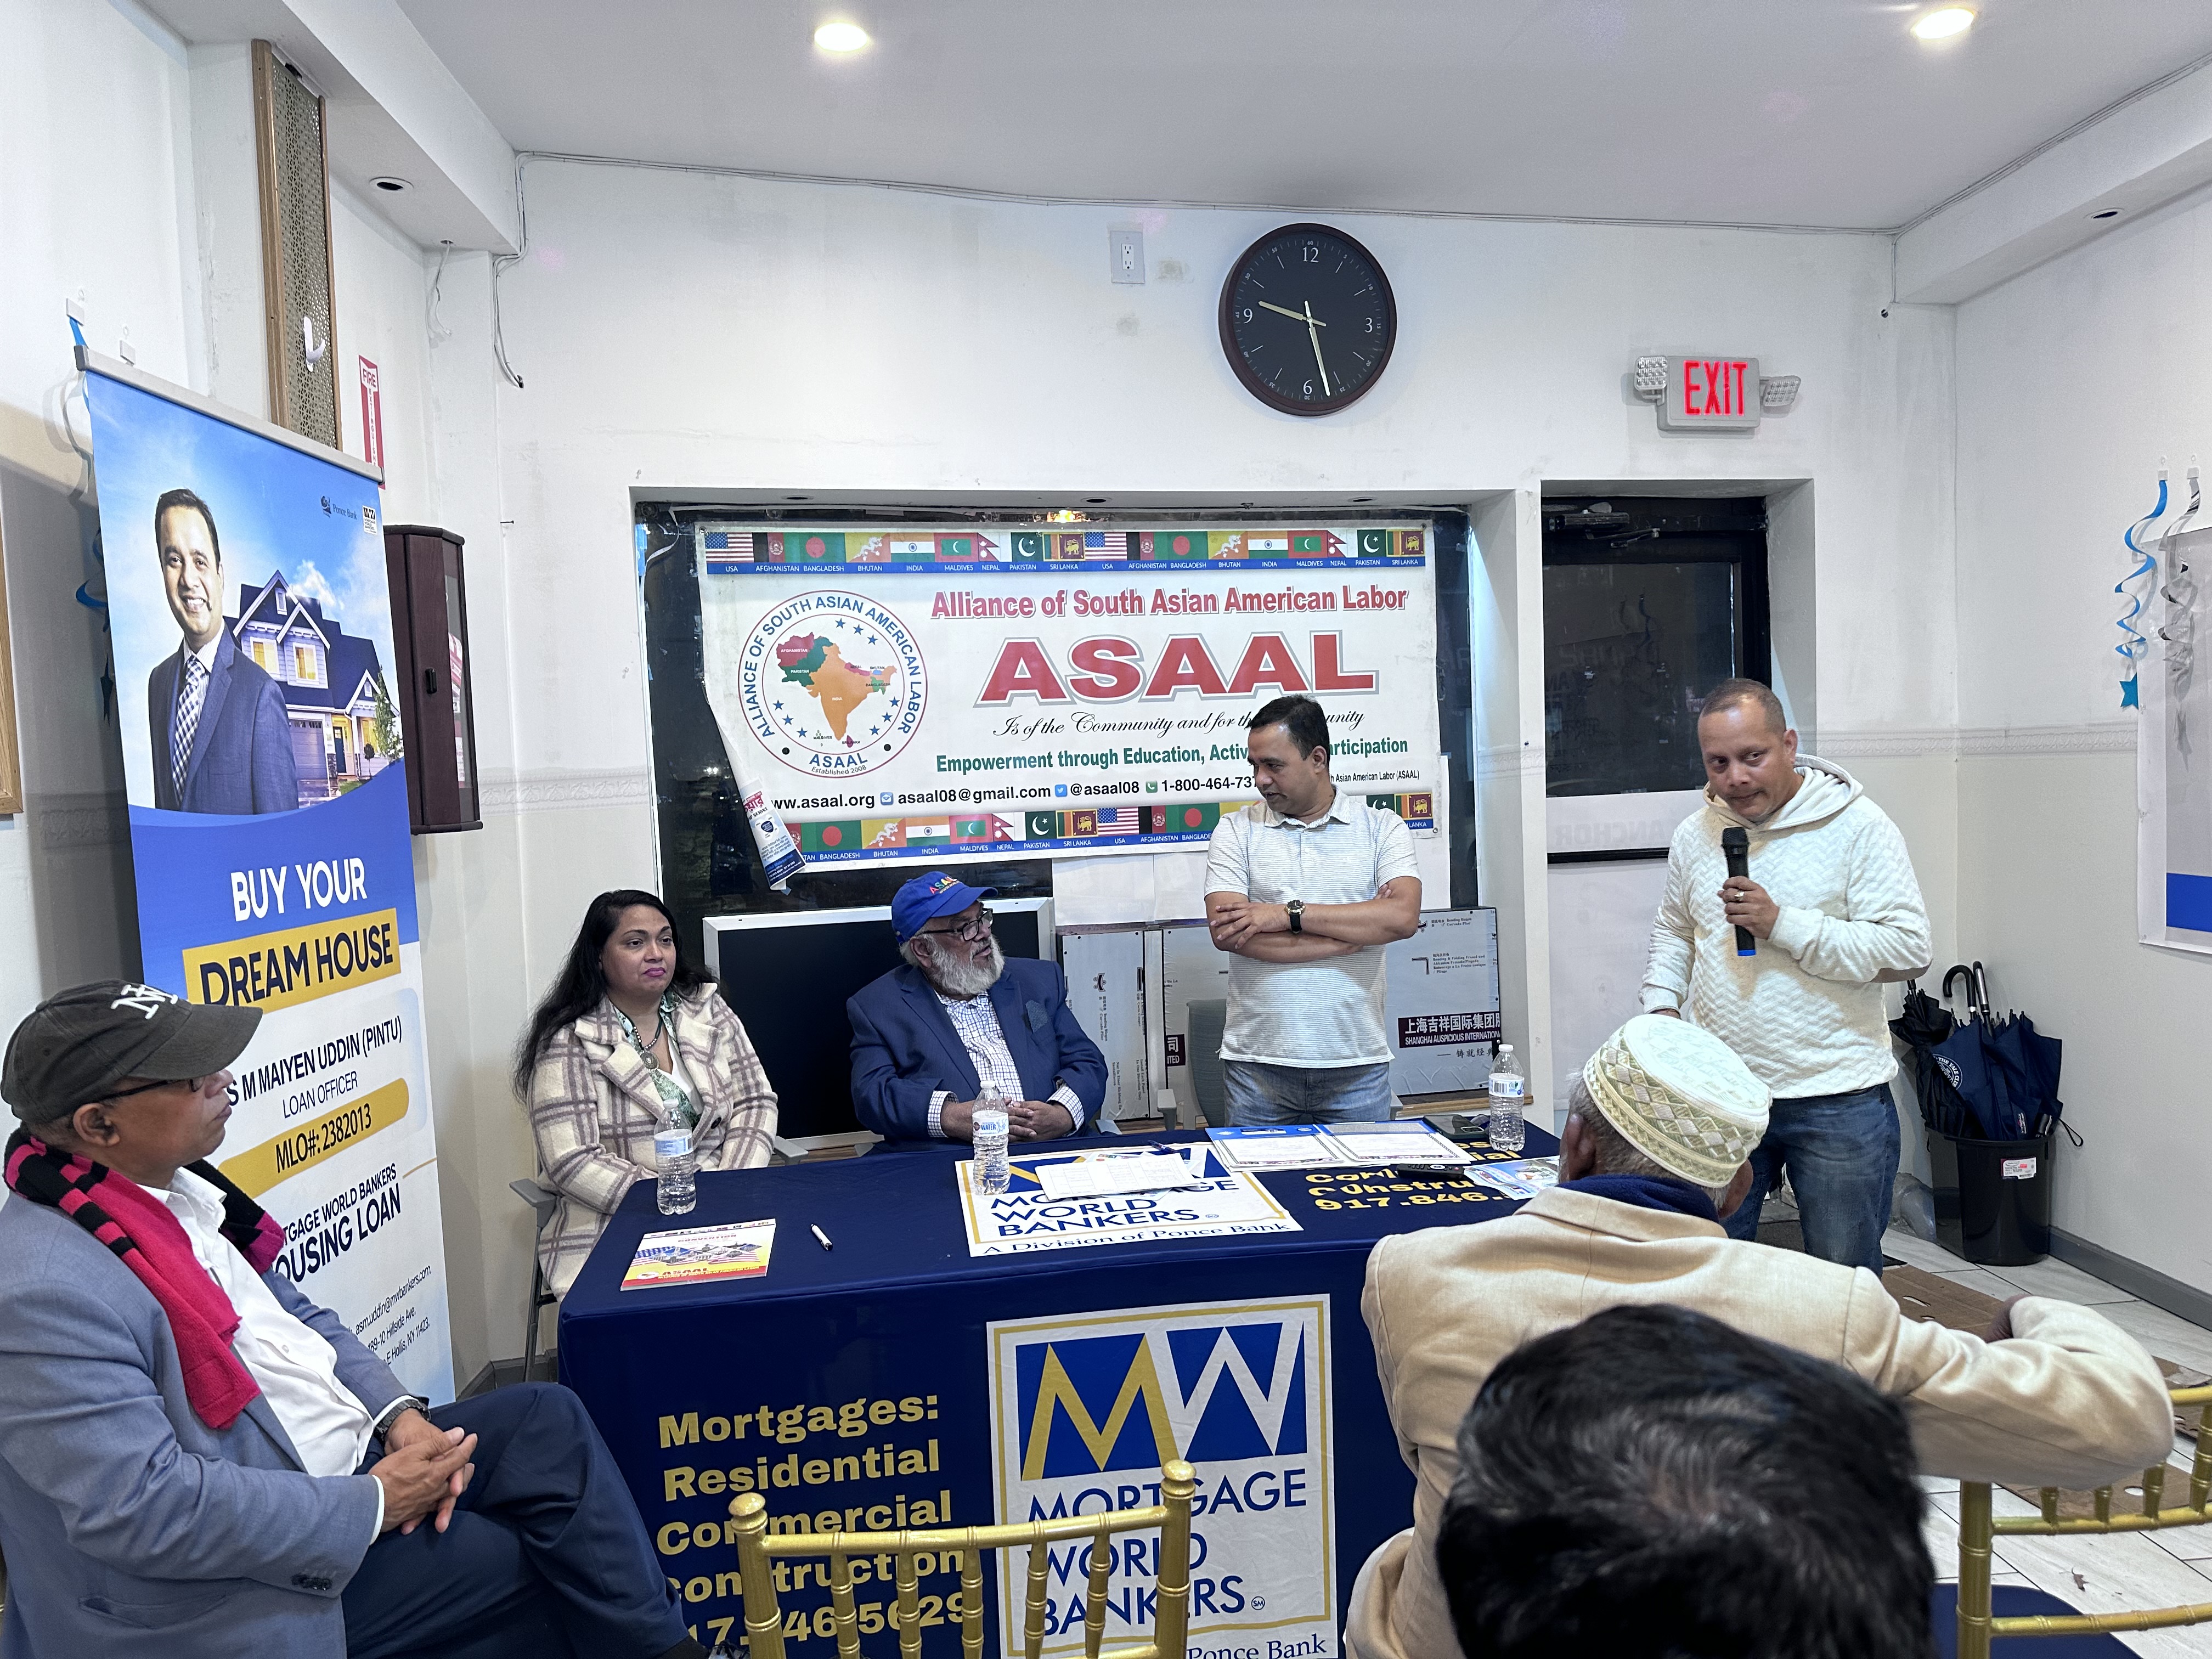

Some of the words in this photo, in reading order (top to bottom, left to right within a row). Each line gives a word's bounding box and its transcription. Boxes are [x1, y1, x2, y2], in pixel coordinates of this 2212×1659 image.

[1302, 246, 1319, 263] 12
[1243, 308, 1253, 324] 9
[1364, 317, 1373, 332] 3
[363, 368, 376, 388] FIRE
[1303, 379, 1312, 394] 6
[1683, 359, 1748, 416] EXIT
[368, 388, 377, 466] EXTINGUISH
[763, 599, 811, 635] SOUTH
[815, 596, 864, 613] ASIAN
[931, 590, 1036, 618] Alliance
[1041, 589, 1067, 617] of
[1074, 588, 1146, 617] South
[1149, 587, 1219, 614] Asian
[1224, 586, 1337, 613] American
[1342, 584, 1408, 611] Labor
[749, 635, 769, 657] OF
[865, 607, 921, 676] AMERICAN
[974, 630, 1379, 707] ASAAL
[744, 661, 775, 737] ALLIANCE
[898, 680, 922, 734] LABOR
[993, 715, 1023, 736] Is
[1022, 718, 1041, 741] of
[1042, 718, 1064, 734] the
[1071, 712, 1173, 738] Community
[1177, 713, 1214, 730] and
[1210, 711, 1235, 734] for
[1238, 711, 1252, 727] th
[1327, 710, 1365, 731] unity
[809, 753, 868, 768] ASAAL
[811, 766, 849, 775] Established
[851, 765, 867, 774] 2008
[936, 751, 1053, 775] Empowerment
[1058, 748, 1118, 769] through
[1124, 745, 1205, 765] Education,
[1209, 743, 1249, 761] Activ
[1329, 737, 1408, 758] articipation
[1336, 774, 1351, 782] Asian
[1353, 772, 1378, 781] American
[1379, 771, 1395, 780] Labor
[1397, 769, 1419, 781] (ASAAL)
[771, 794, 875, 810] ww.asaal.org
[898, 786, 1051, 804] asaal08@gmail.com
[1070, 781, 1140, 797] @asaal08
[820, 851, 860, 860] BANGLADESH
[230, 866, 287, 922] BUY
[295, 857, 367, 910] YOUR
[199, 941, 311, 1006] DREAM
[314, 922, 393, 983] HOUSE
[1167, 1036, 1179, 1053] 司
[1405, 1035, 1432, 1045] SHANGHAI
[1434, 1032, 1464, 1043] AUSPICIOUS
[1465, 1030, 1500, 1041] INTERNATION
[226, 1079, 239, 1107] S
[241, 1071, 257, 1101] M
[258, 1049, 316, 1094] MAIYEN
[317, 1032, 360, 1070] UDDIN
[362, 1015, 402, 1058] (PINTU)
[1938, 1057, 1950, 1065] THE
[283, 1087, 316, 1119] LOAN
[317, 1070, 358, 1105] OFFICER
[275, 1128, 321, 1173] MLO#:
[321, 1103, 371, 1152] 2382013
[283, 1209, 320, 1246] TGAGE
[321, 1187, 357, 1223] WORLD
[359, 1163, 397, 1200] BANKERS
[991, 1199, 1157, 1223] WORLD
[1314, 1190, 1510, 1210] 917.846.
[275, 1215, 353, 1283] OUSING
[357, 1183, 402, 1242] LOAN
[983, 1246, 1002, 1255] A
[1011, 1235, 1113, 1251] Division
[1121, 1232, 1144, 1241] of
[1153, 1226, 1217, 1238] Ponce
[1230, 1223, 1291, 1234] Bank
[998, 1209, 1200, 1237] BANKERS
[356, 1265, 432, 1336] asm.uddin@mwbankers.com
[386, 1314, 405, 1340] Hillside
[405, 1306, 416, 1323] Ave.
[387, 1351, 392, 1365] E
[391, 1338, 408, 1362] Hollis,
[407, 1327, 415, 1347] NY
[415, 1316, 430, 1338] 11423.
[1021, 1321, 1305, 1481] MW
[659, 1395, 938, 1448] Mortgages:
[664, 1438, 939, 1501] Residential
[668, 1551, 964, 1603] ontructon
[1043, 1575, 1245, 1637] BANKRS
[1267, 1633, 1327, 1657] Bank
